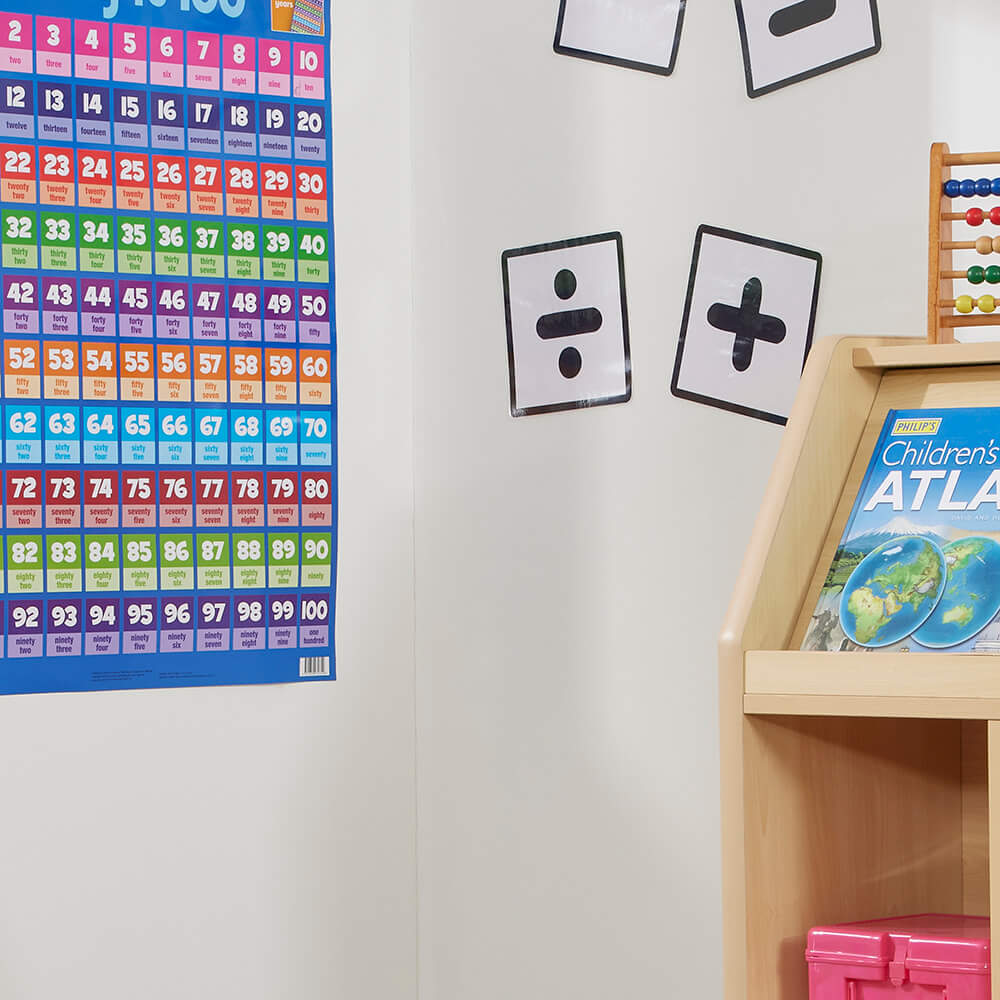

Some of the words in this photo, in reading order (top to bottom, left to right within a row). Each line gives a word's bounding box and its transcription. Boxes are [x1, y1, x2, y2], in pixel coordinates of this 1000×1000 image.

[8, 19, 22, 43] 2
[46, 23, 61, 47] 3
[84, 28, 99, 50] 4
[123, 31, 137, 54] 5
[159, 35, 174, 57] 6
[197, 39, 210, 60] 7
[232, 43, 246, 65] 8
[268, 46, 282, 67] 9
[299, 49, 319, 72] 10
[9, 56, 21, 64] two
[46, 59, 62, 68] three
[195, 74, 212, 82] seven
[6, 85, 26, 108] 12
[45, 89, 65, 112] 13
[82, 92, 103, 115] 14
[120, 95, 140, 119] 15
[157, 99, 177, 121] 16
[195, 102, 213, 123] 17
[230, 105, 249, 127] 18
[265, 108, 285, 129] 19
[296, 110, 322, 134] 20
[6, 121, 28, 130] twelve
[43, 123, 68, 133] thirteen
[190, 137, 219, 145] seventeen
[300, 145, 320, 154] twenty
[4, 150, 32, 174] 22
[43, 153, 70, 177] 23
[81, 155, 109, 179] 24
[119, 158, 146, 182] 25
[156, 161, 183, 185] 26
[193, 164, 218, 186] 27
[229, 166, 254, 190] 28
[264, 169, 289, 191] 29
[298, 172, 324, 195] 30
[5, 215, 33, 239] 32
[44, 218, 71, 241] 33
[82, 220, 110, 243] 34
[120, 222, 147, 246] 35
[158, 224, 184, 248] 36
[195, 227, 220, 249] 37
[231, 229, 256, 252] 38
[266, 231, 291, 253] 39
[299, 234, 326, 256] 40
[6, 281, 34, 304] 42
[45, 283, 73, 306] 43
[83, 285, 112, 307] 44
[122, 287, 149, 310] 45
[158, 289, 186, 311] 46
[196, 290, 221, 311] 47
[231, 292, 257, 314] 48
[267, 294, 292, 314] 49
[301, 295, 327, 317] 50
[8, 346, 36, 370] 52
[48, 348, 75, 371] 53
[86, 349, 113, 372] 54
[124, 350, 150, 373] 55
[161, 351, 187, 374] 56
[199, 352, 222, 375] 57
[234, 353, 258, 376] 58
[269, 355, 293, 377] 59
[302, 356, 328, 378] 60
[9, 411, 37, 434] 62
[48, 412, 76, 435] 63
[86, 413, 114, 435] 64
[124, 414, 151, 436] 65
[161, 414, 188, 436] 66
[199, 415, 223, 436] 67
[234, 416, 259, 437] 68
[269, 416, 294, 437] 69
[303, 417, 327, 438] 70
[896, 421, 938, 432] PHILIP'S
[882, 439, 1000, 466] Children's
[11, 476, 37, 499] 72
[50, 476, 76, 499] 73
[89, 478, 113, 499] 74
[126, 477, 151, 500] 75
[163, 477, 188, 499] 76
[200, 478, 224, 499] 77
[236, 478, 260, 499] 78
[271, 478, 295, 499] 79
[304, 478, 329, 499] 80
[11, 541, 39, 564] 82
[50, 541, 77, 563] 83
[88, 541, 116, 563] 84
[126, 540, 153, 563] 85
[163, 540, 190, 562] 86
[201, 540, 225, 561] 87
[236, 539, 261, 561] 88
[271, 539, 296, 561] 89
[304, 539, 329, 560] 90
[12, 606, 40, 628] 92
[51, 605, 78, 627] 93
[89, 604, 116, 626] 94
[127, 603, 154, 626] 95
[164, 602, 191, 624] 96
[201, 602, 226, 623] 97
[237, 601, 262, 622] 98
[271, 600, 295, 621] 99
[301, 599, 328, 621] 100
